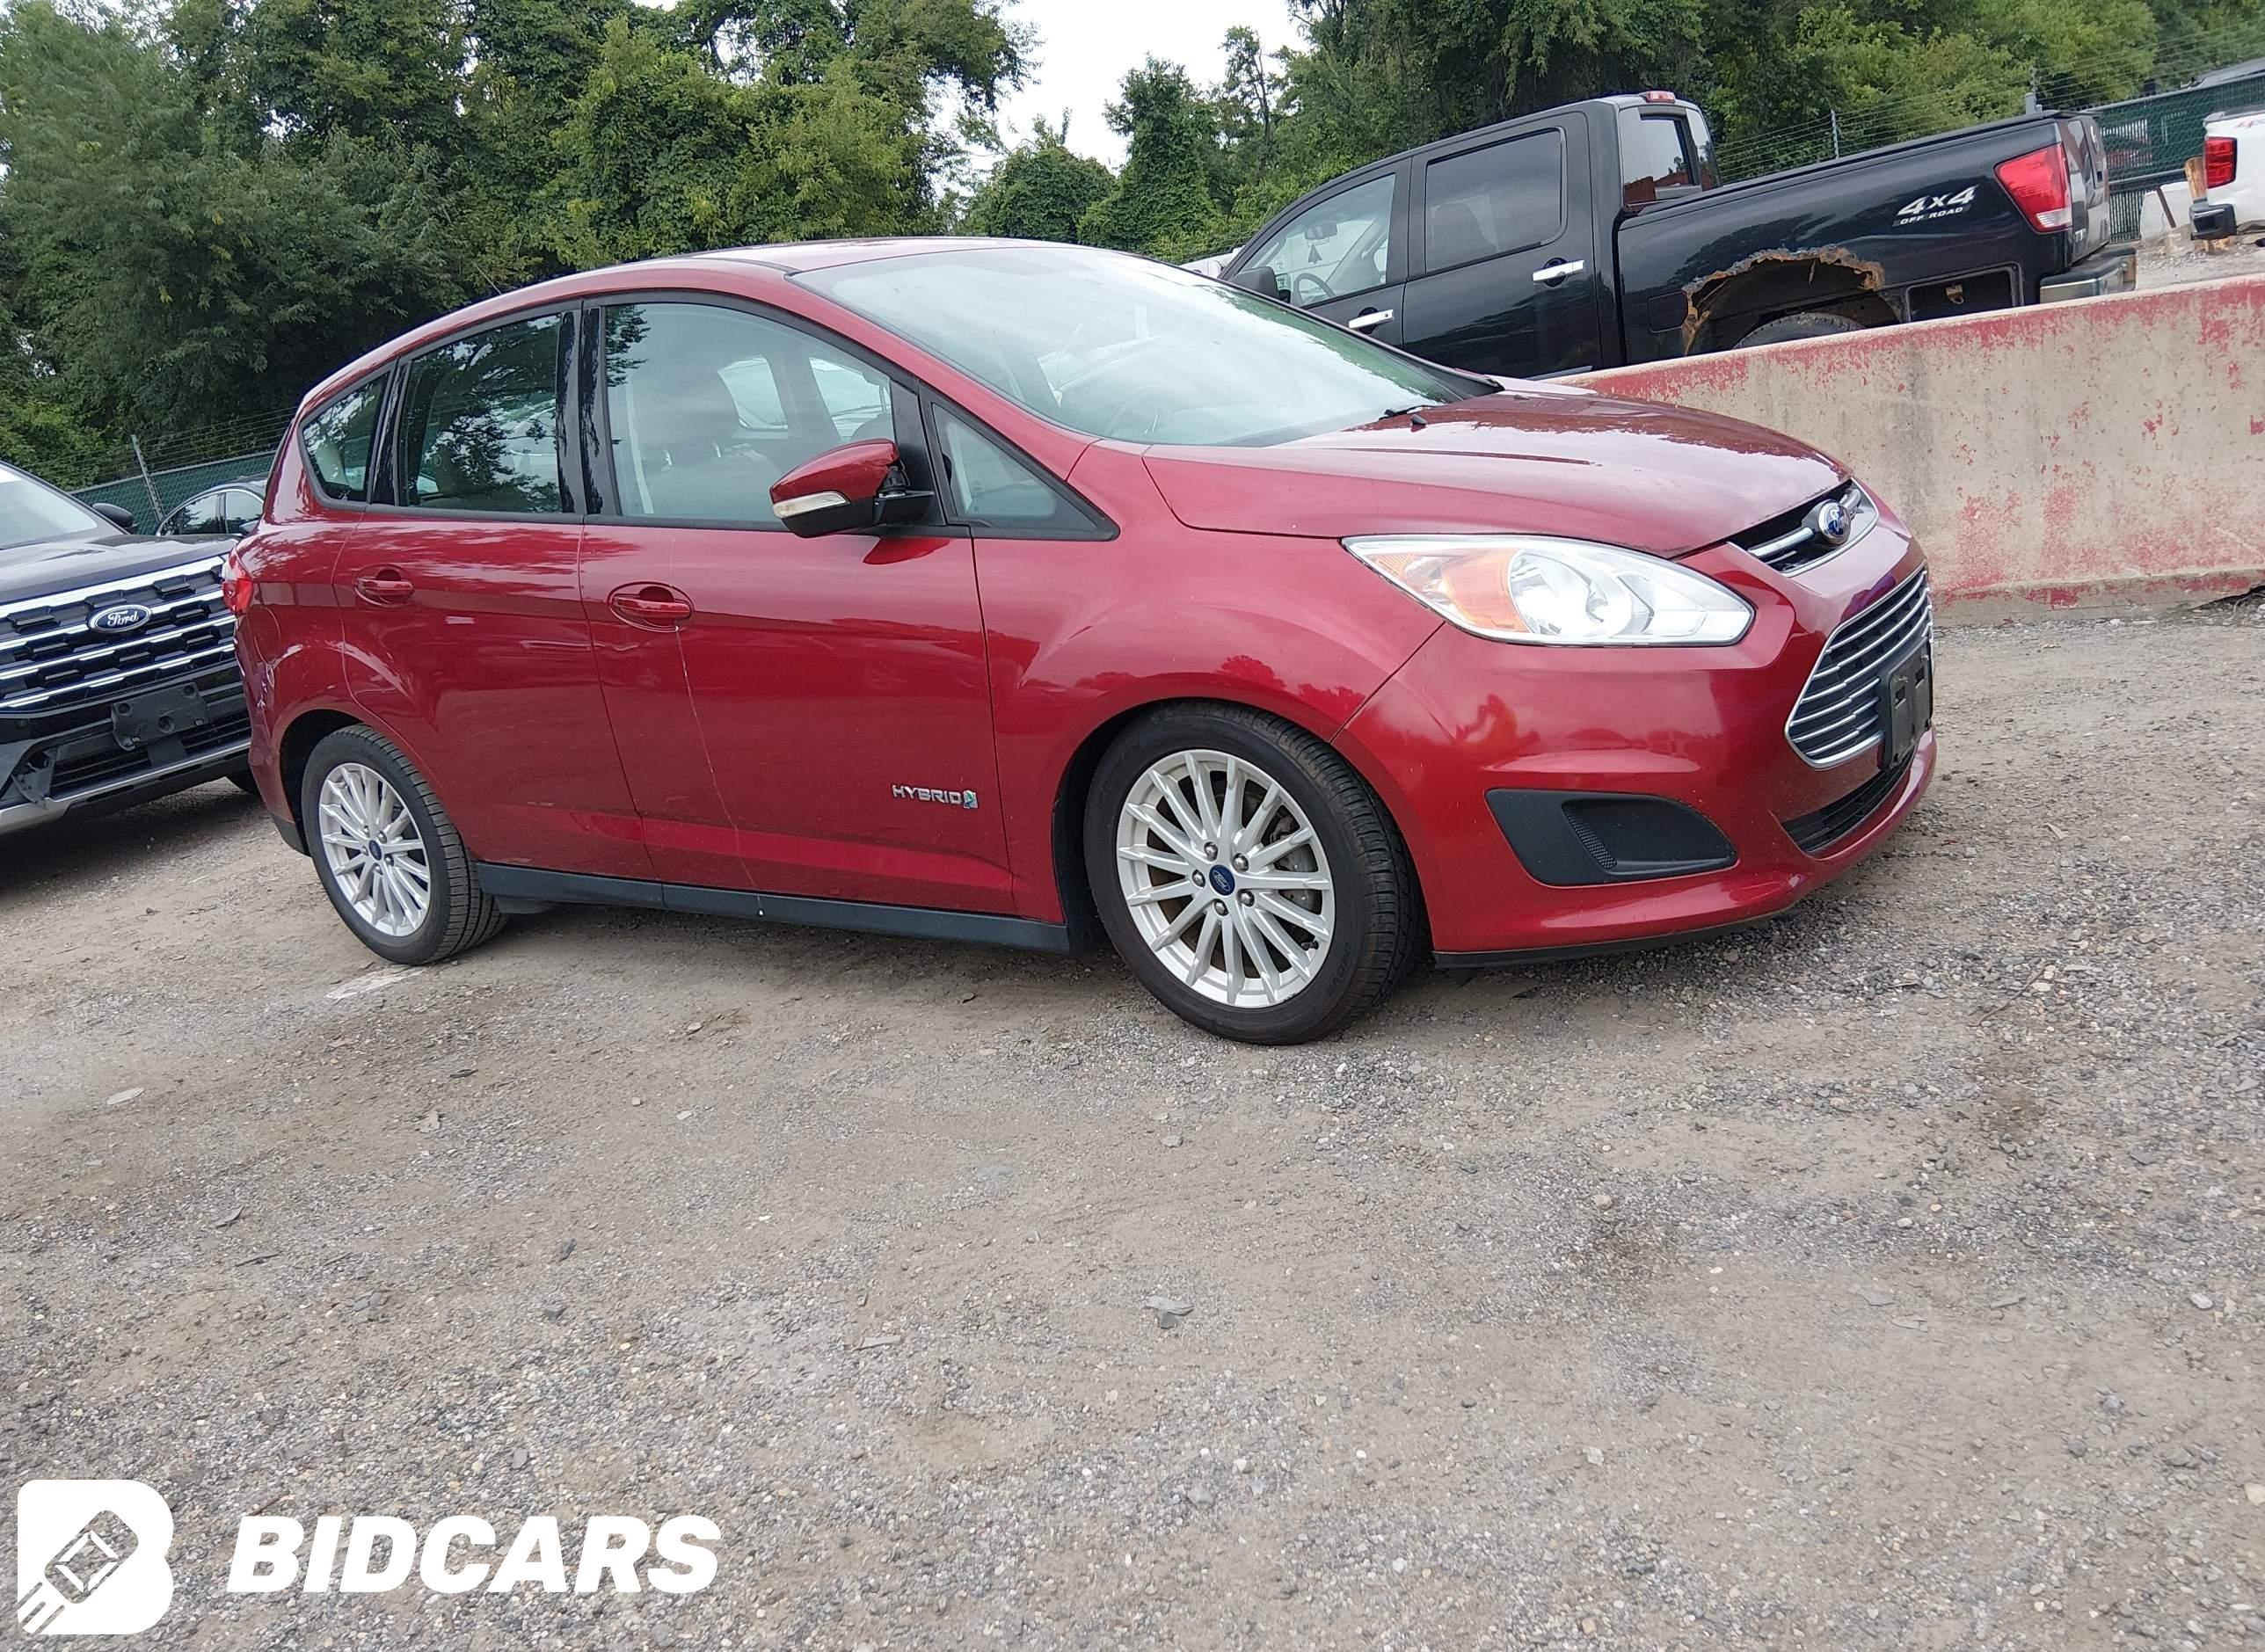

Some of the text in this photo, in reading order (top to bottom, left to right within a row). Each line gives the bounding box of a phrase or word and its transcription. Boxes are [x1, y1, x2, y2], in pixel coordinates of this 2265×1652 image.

[1899, 207, 1963, 225] OFF ROAD
[106, 610, 139, 627] Ford
[892, 784, 962, 805] HYBRID
